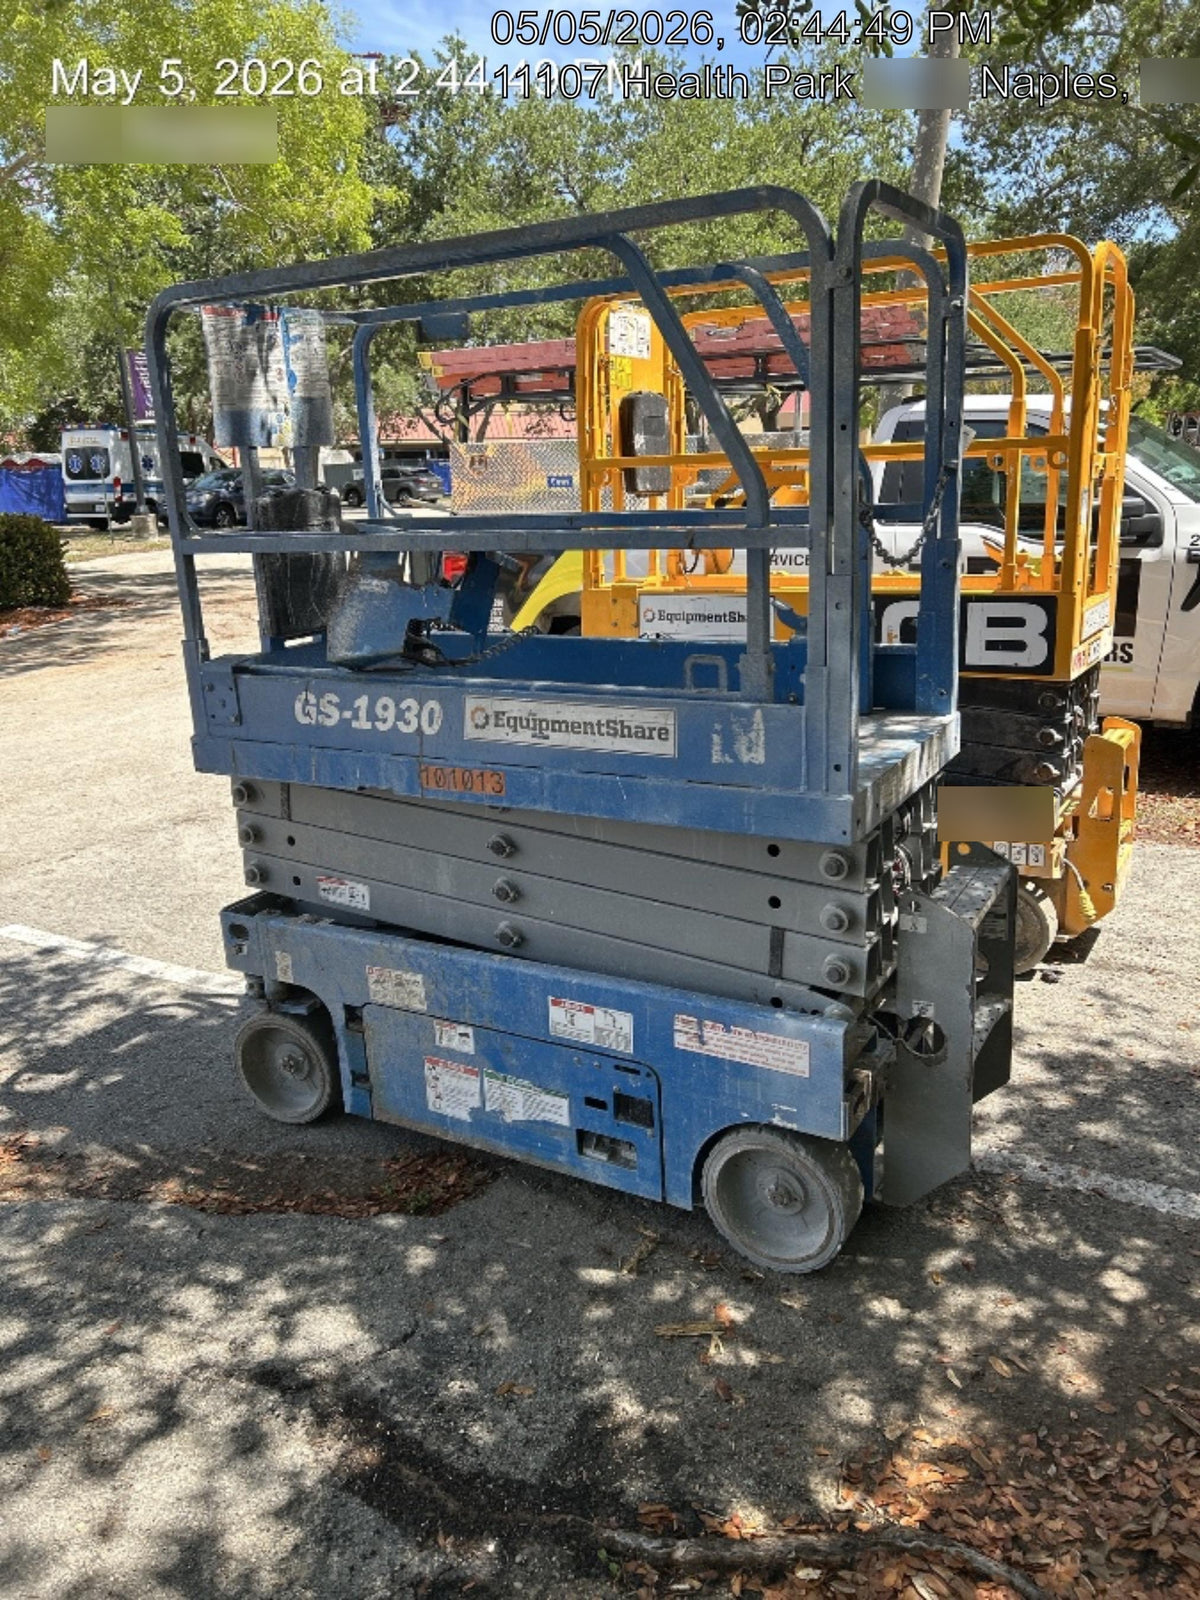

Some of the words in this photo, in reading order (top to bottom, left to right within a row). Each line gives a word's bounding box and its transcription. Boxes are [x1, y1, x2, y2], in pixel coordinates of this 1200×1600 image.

[657, 608, 747, 625] EquipmentSh
[293, 690, 444, 736] GS-1930
[493, 709, 671, 742] EquipmentShare
[421, 765, 505, 795] 101013
